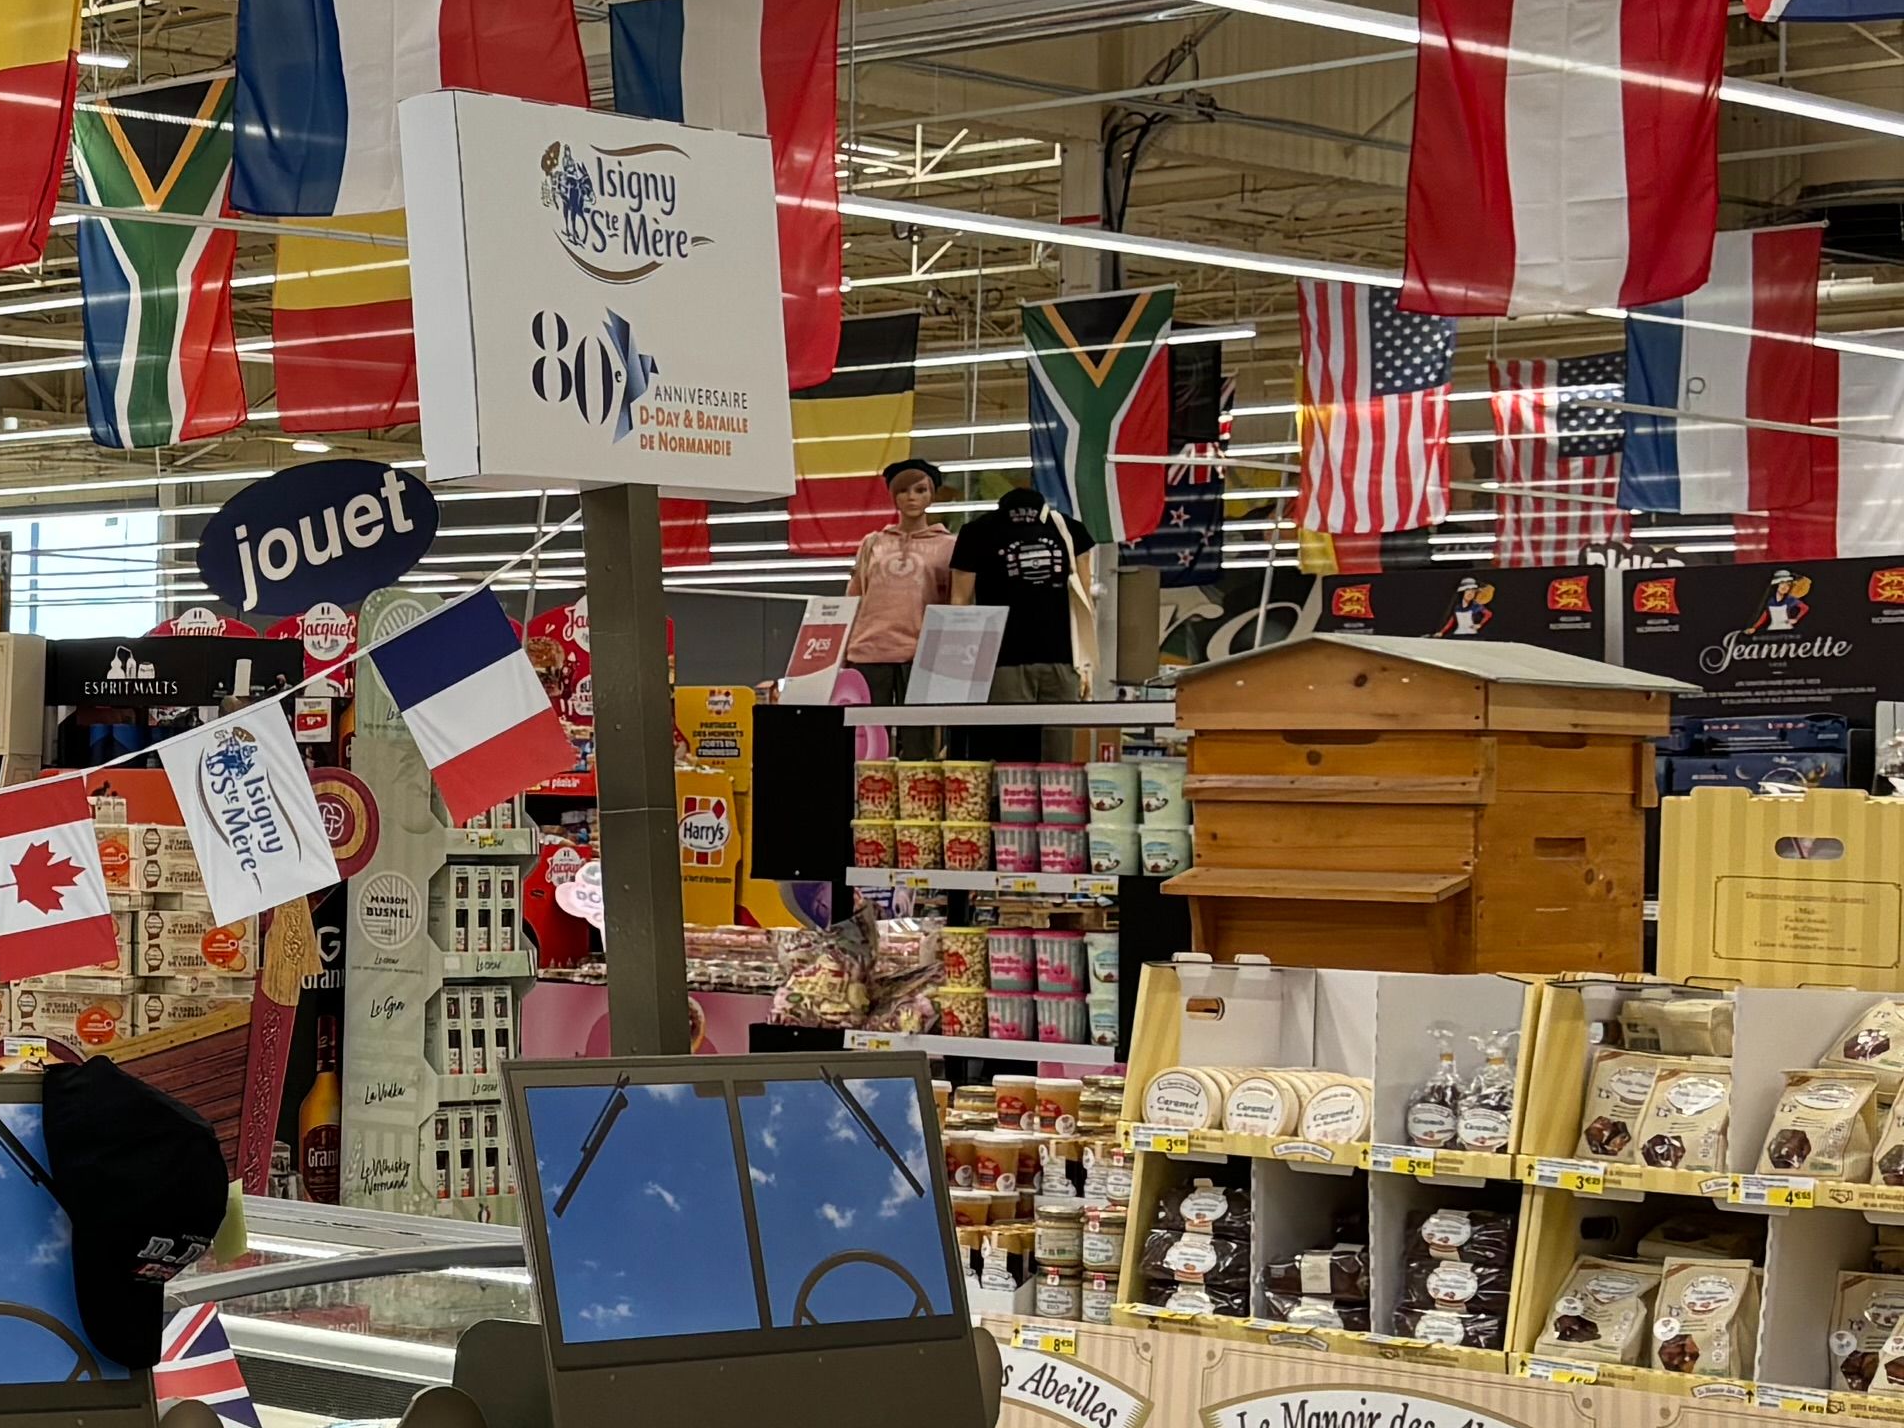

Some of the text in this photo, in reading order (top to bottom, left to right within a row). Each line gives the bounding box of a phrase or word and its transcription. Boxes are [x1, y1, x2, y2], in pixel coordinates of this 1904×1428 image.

[596, 155, 677, 216] Isigny
[623, 212, 689, 259] Mère
[654, 385, 749, 410] ANNIVERSAIRE
[683, 410, 694, 428] &
[234, 469, 414, 613] jouet
[297, 614, 357, 643] Jacquet
[1699, 629, 1853, 675] Jeannette
[243, 774, 284, 854] Isigny
[221, 807, 257, 872] Mère
[365, 907, 412, 920] BUSNEL
[1156, 1095, 1199, 1113] Caramel
[1235, 1100, 1274, 1116] Caramel
[1312, 1104, 1356, 1123] Caramel
